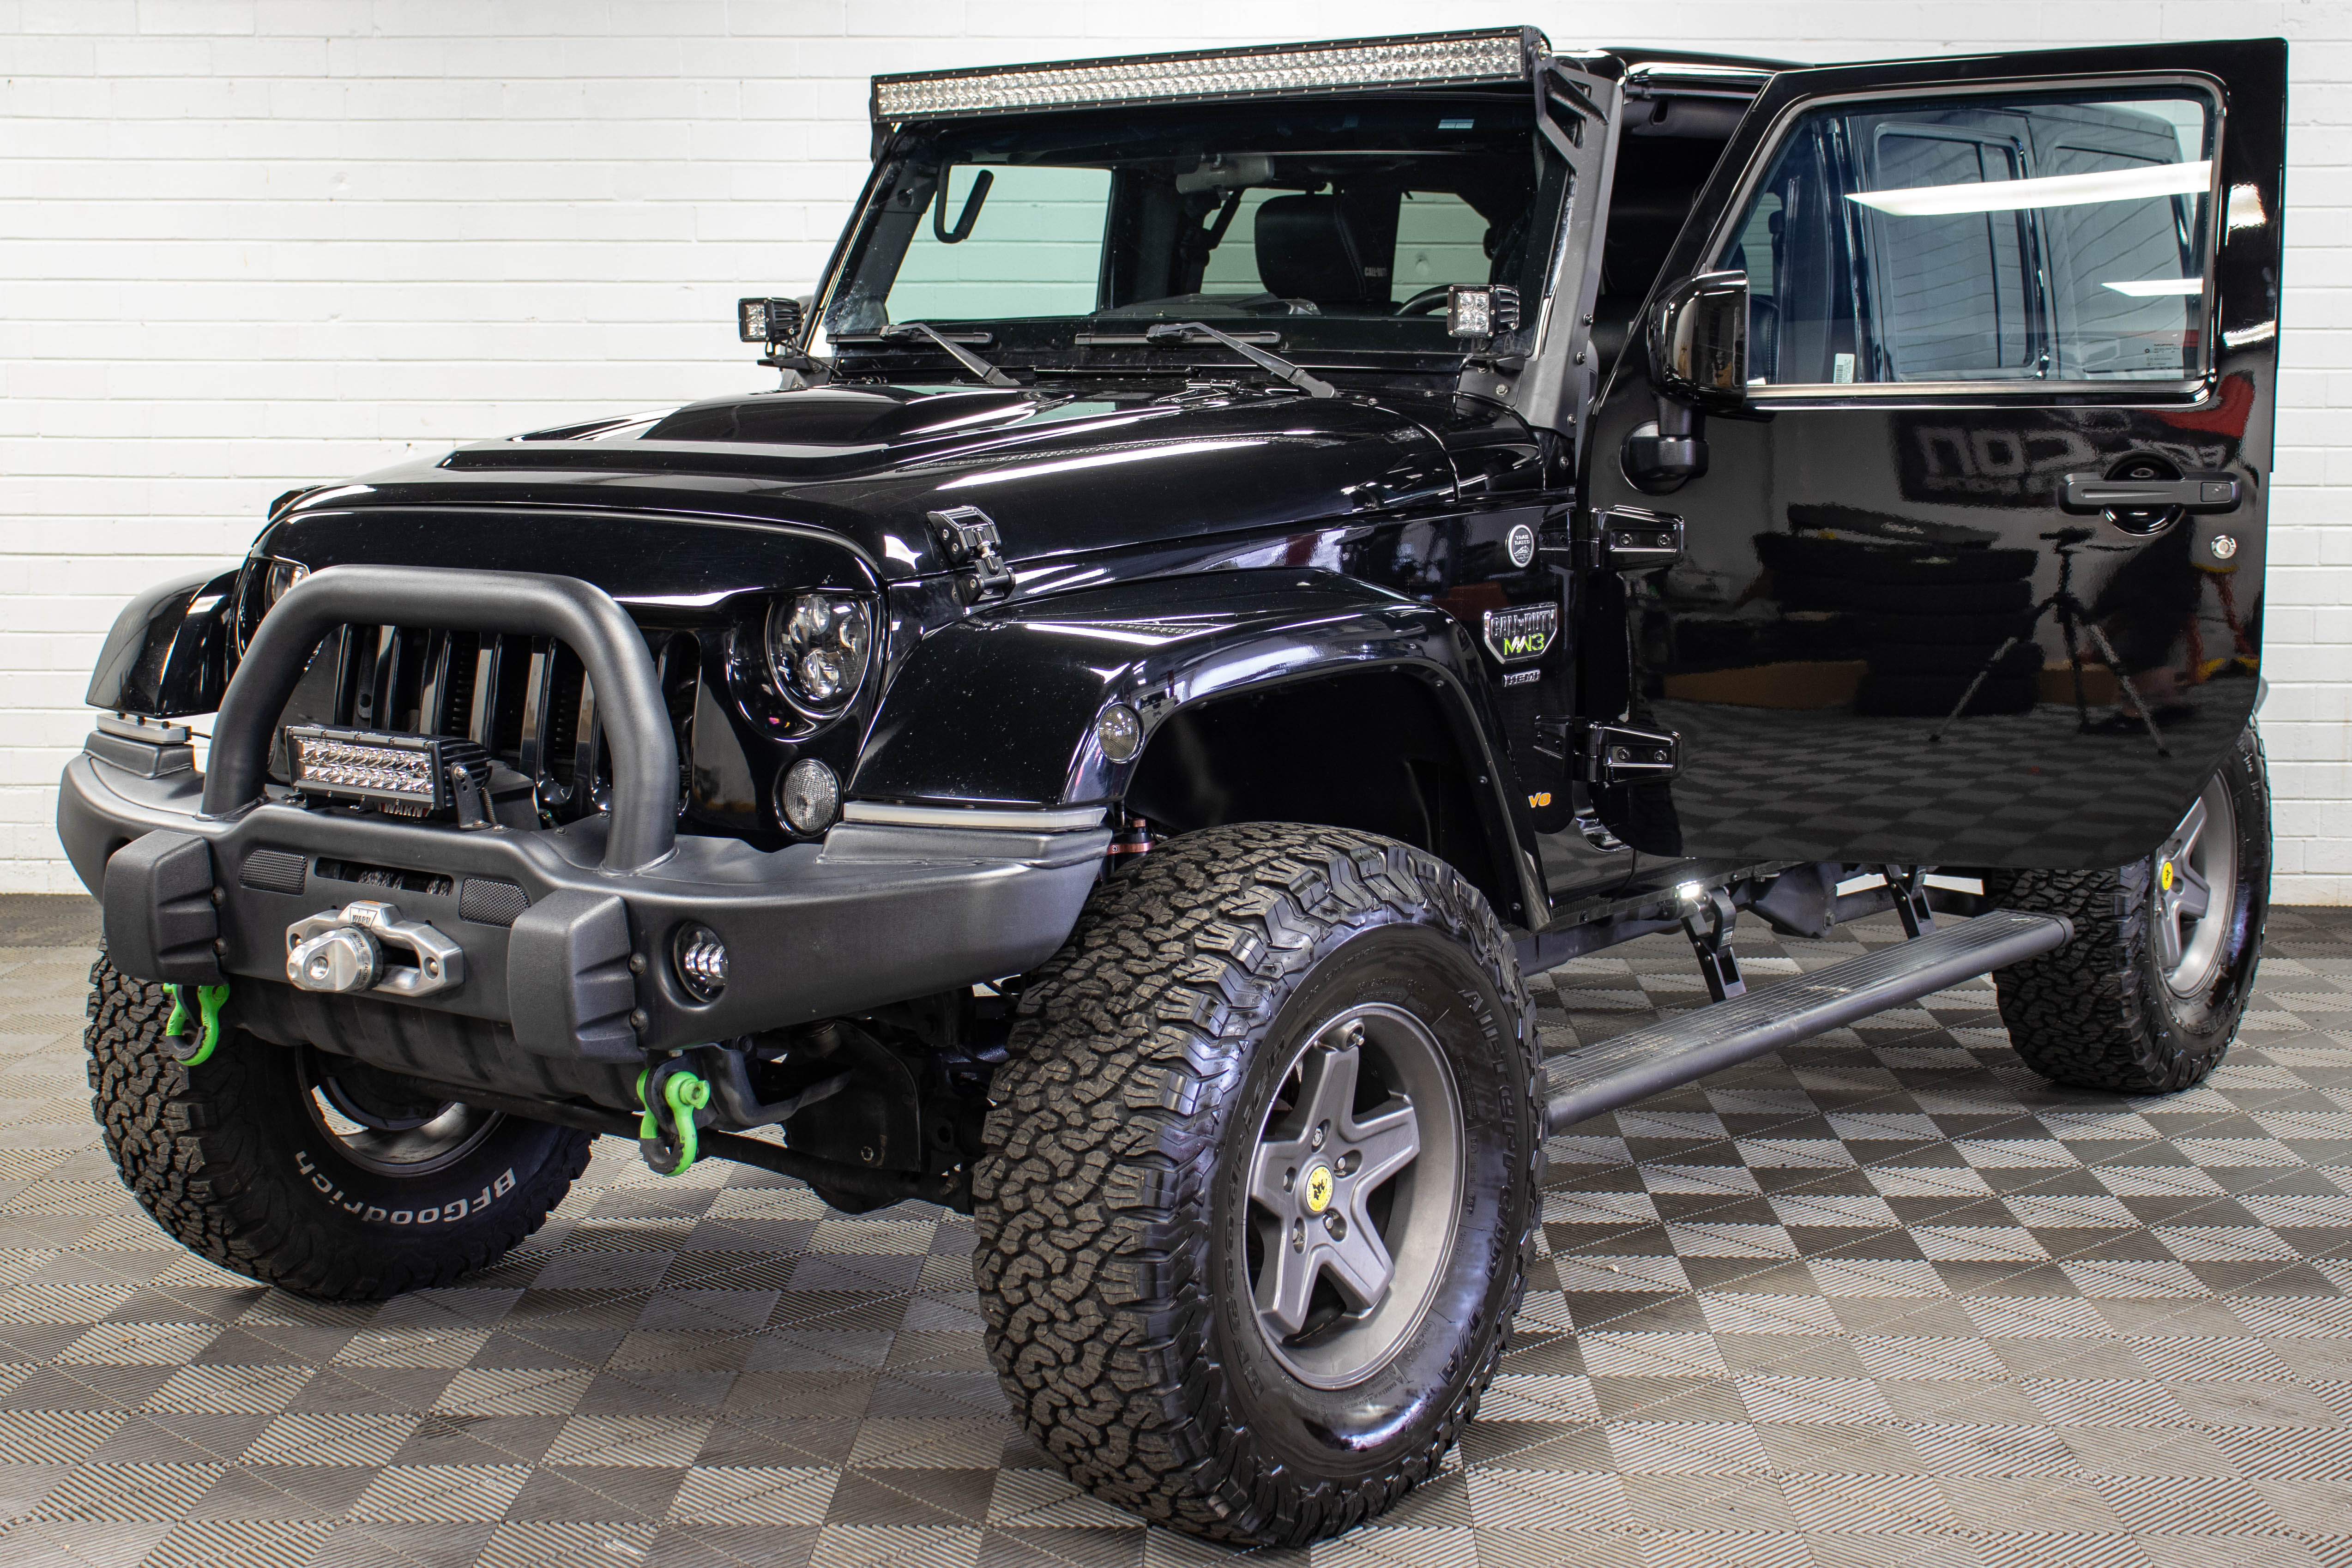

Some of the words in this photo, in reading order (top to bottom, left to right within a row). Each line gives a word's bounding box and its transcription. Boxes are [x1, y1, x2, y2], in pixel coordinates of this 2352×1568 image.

[1491, 614, 1518, 639] CALL
[1524, 609, 1555, 634] DUTY
[1504, 633, 1544, 656] MW3
[1506, 670, 1540, 685] HEMI
[383, 802, 423, 817] WARN
[1528, 792, 1551, 808] V8
[352, 914, 371, 925] WARN
[295, 1150, 517, 1224] BFGoodrich
[1225, 1035, 1285, 1400] BFGoodrich
